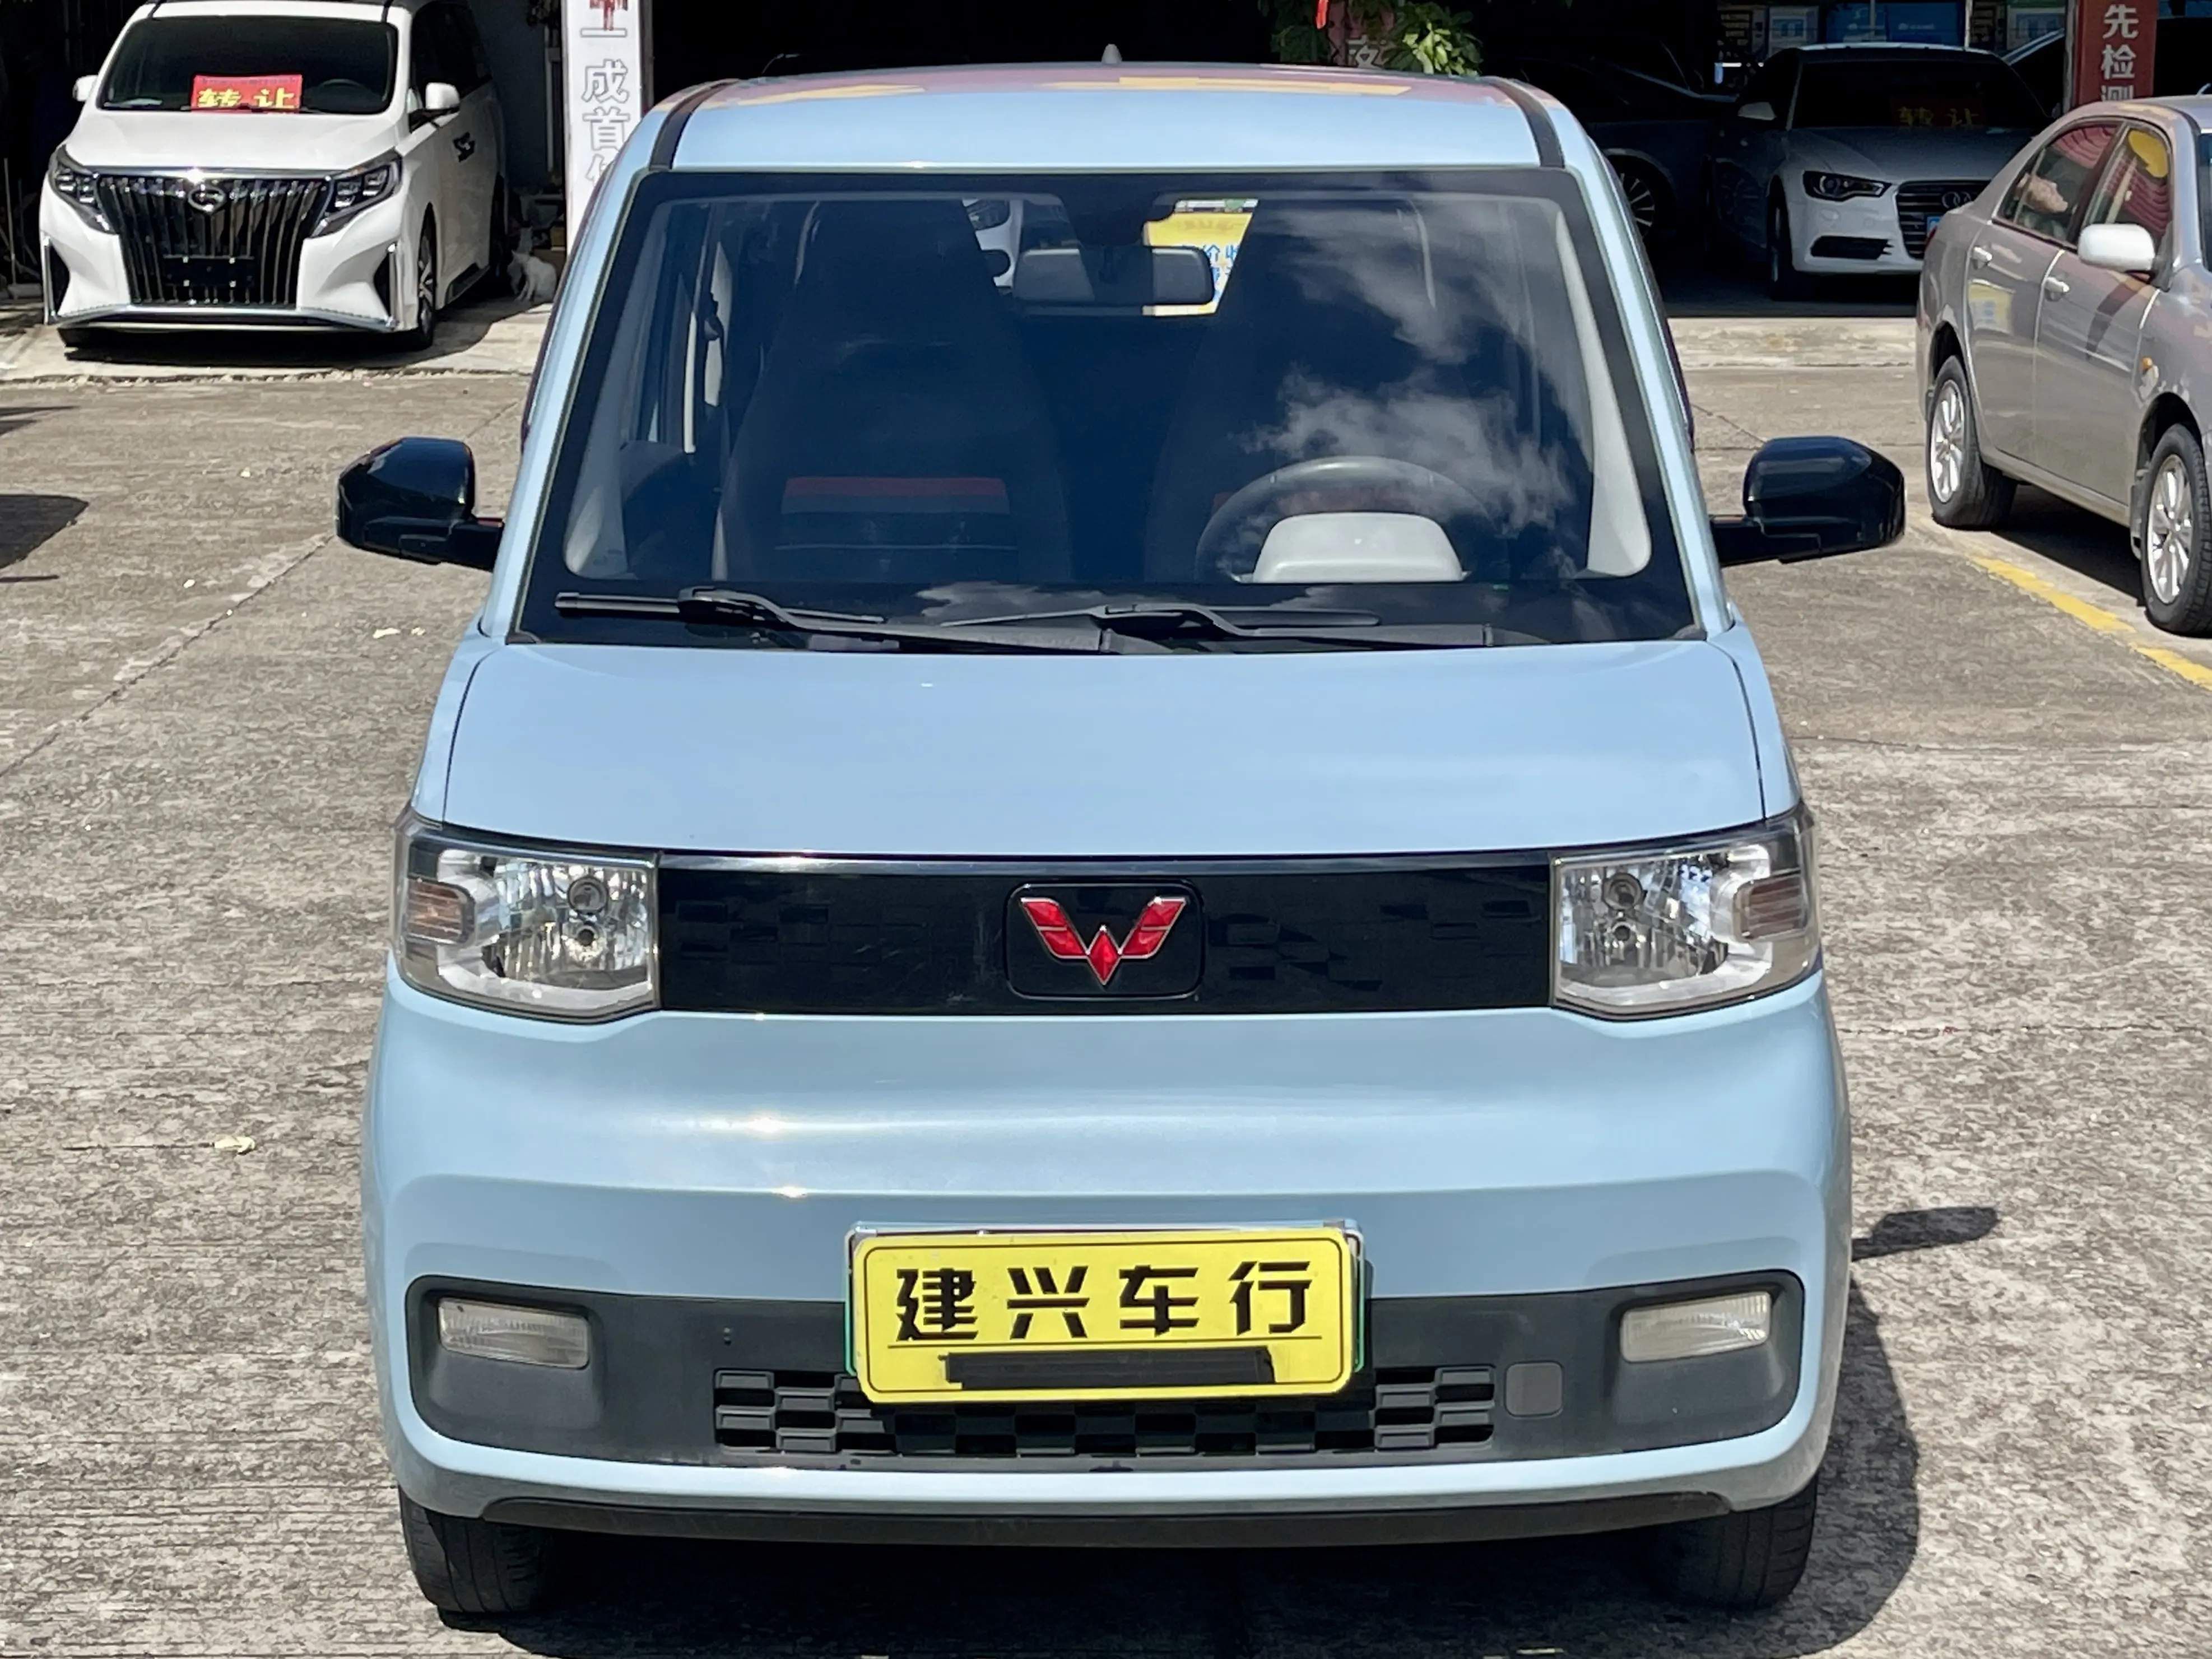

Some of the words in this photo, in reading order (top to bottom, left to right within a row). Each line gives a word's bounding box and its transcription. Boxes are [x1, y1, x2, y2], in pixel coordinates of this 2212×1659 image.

[197, 88, 295, 109] 转让
[896, 1260, 1313, 1342] 建兴车行
